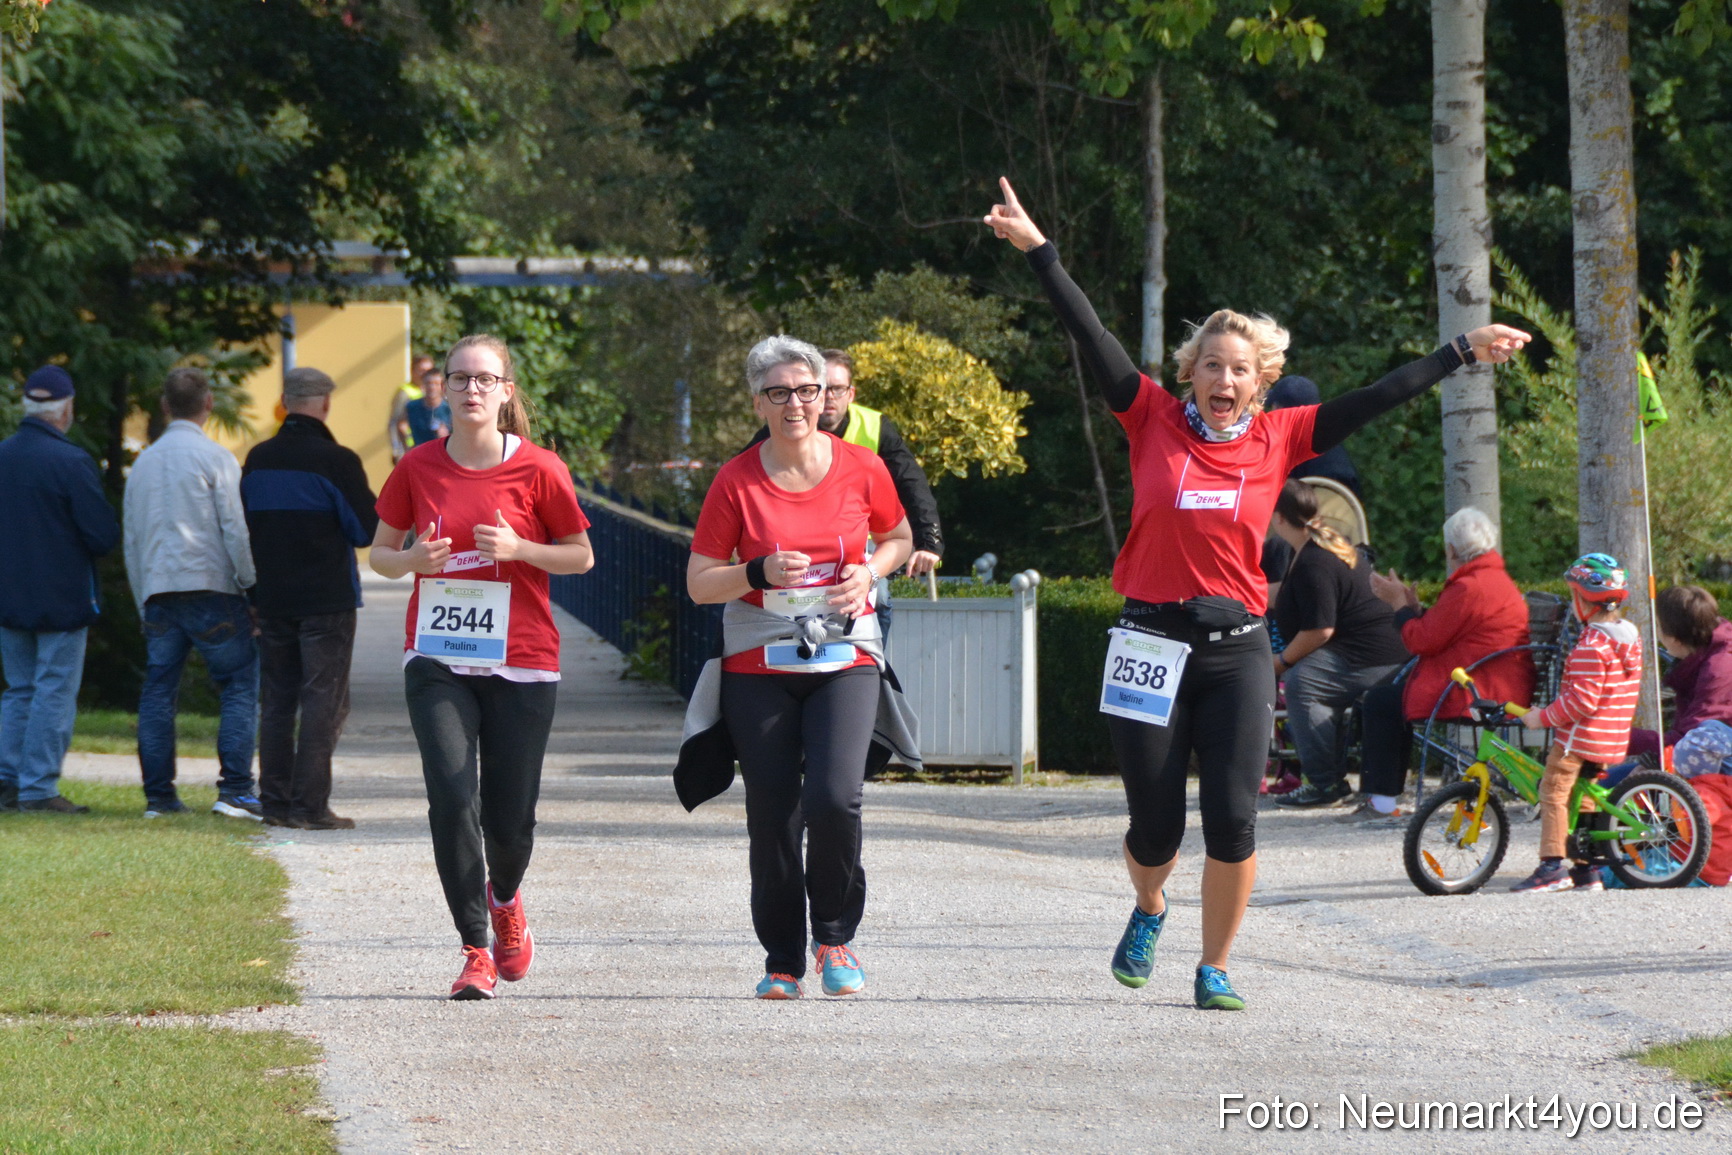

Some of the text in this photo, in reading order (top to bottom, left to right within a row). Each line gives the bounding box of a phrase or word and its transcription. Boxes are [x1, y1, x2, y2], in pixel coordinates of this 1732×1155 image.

[457, 555, 480, 566] DEHN
[454, 588, 484, 596] BOCK
[430, 605, 494, 633] 2544
[1135, 624, 1167, 637] SALOMON
[444, 640, 477, 651] Paulina
[1132, 640, 1162, 653] BOCK
[1112, 655, 1168, 690] 2538
[1119, 691, 1144, 705] Nadine
